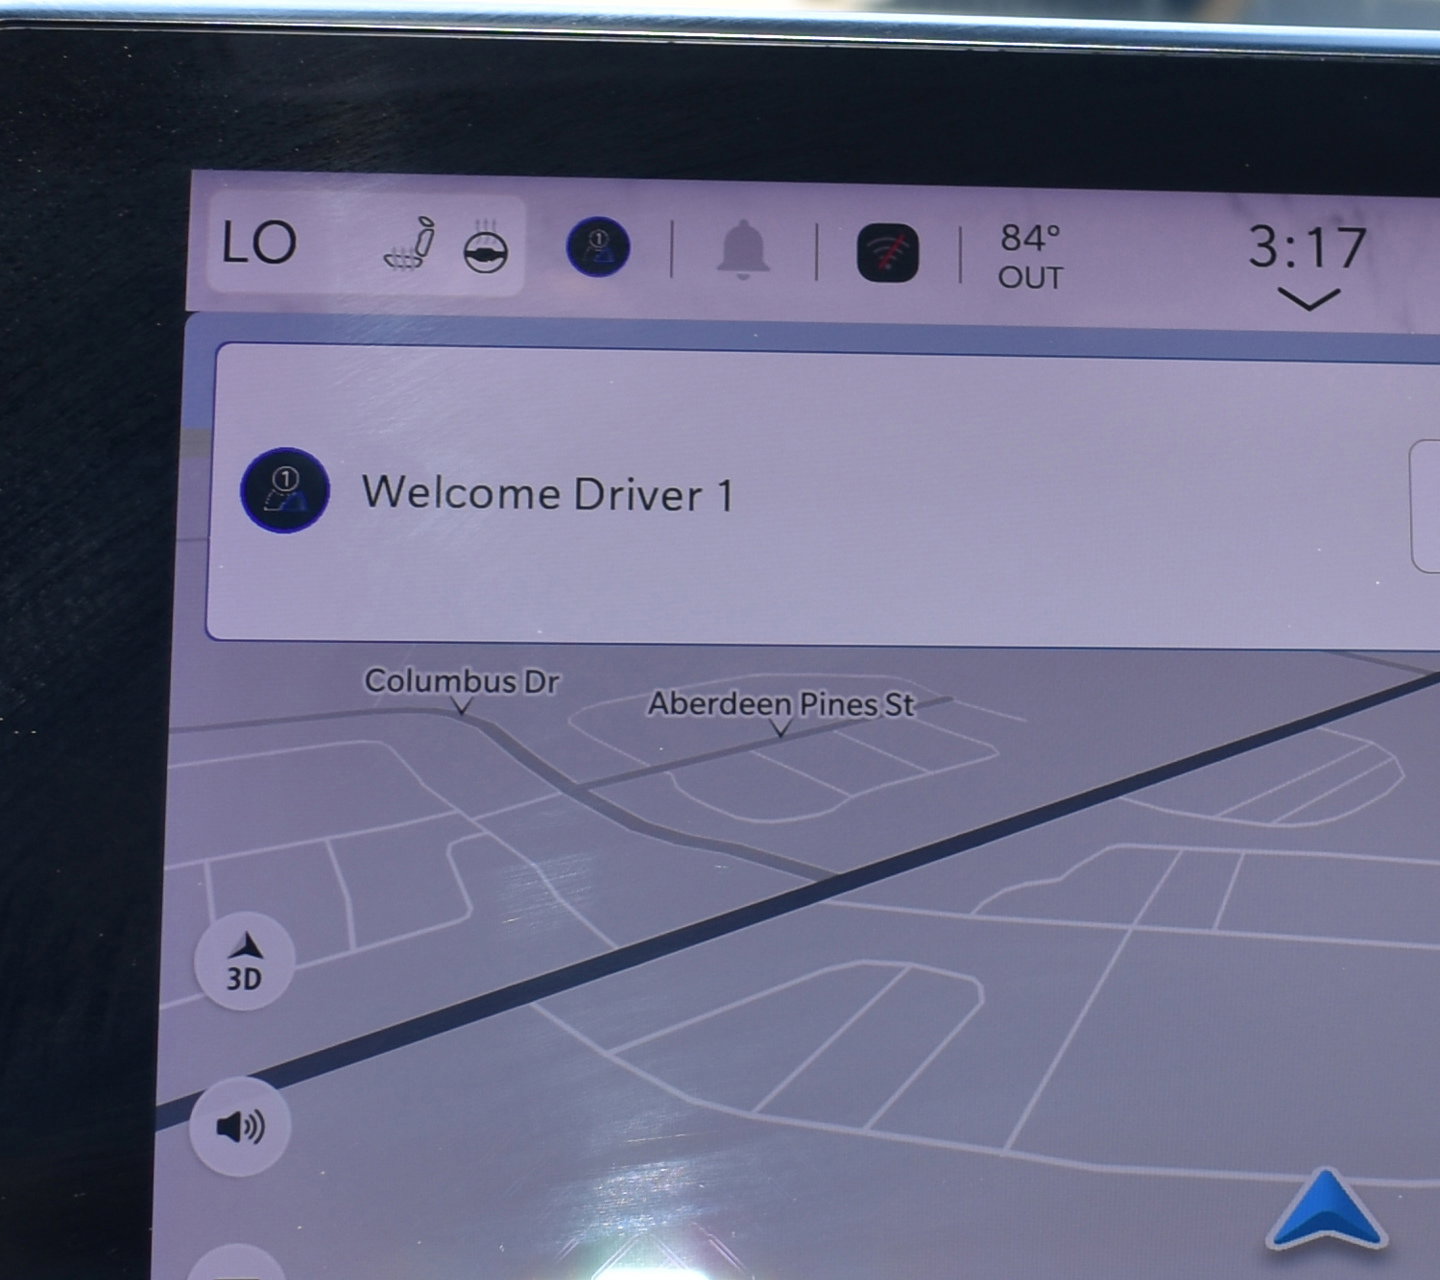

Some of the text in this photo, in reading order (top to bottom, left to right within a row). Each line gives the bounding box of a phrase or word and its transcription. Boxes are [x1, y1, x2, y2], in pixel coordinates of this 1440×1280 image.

[223, 219, 297, 265] LO
[1249, 224, 1367, 269] 3:17
[998, 265, 1065, 290] OUT
[362, 474, 730, 512] Welcome Driver 1
[365, 668, 560, 694] Columbus Dr
[648, 690, 914, 717] Aberdeen Pines St
[227, 966, 262, 991] 3D
